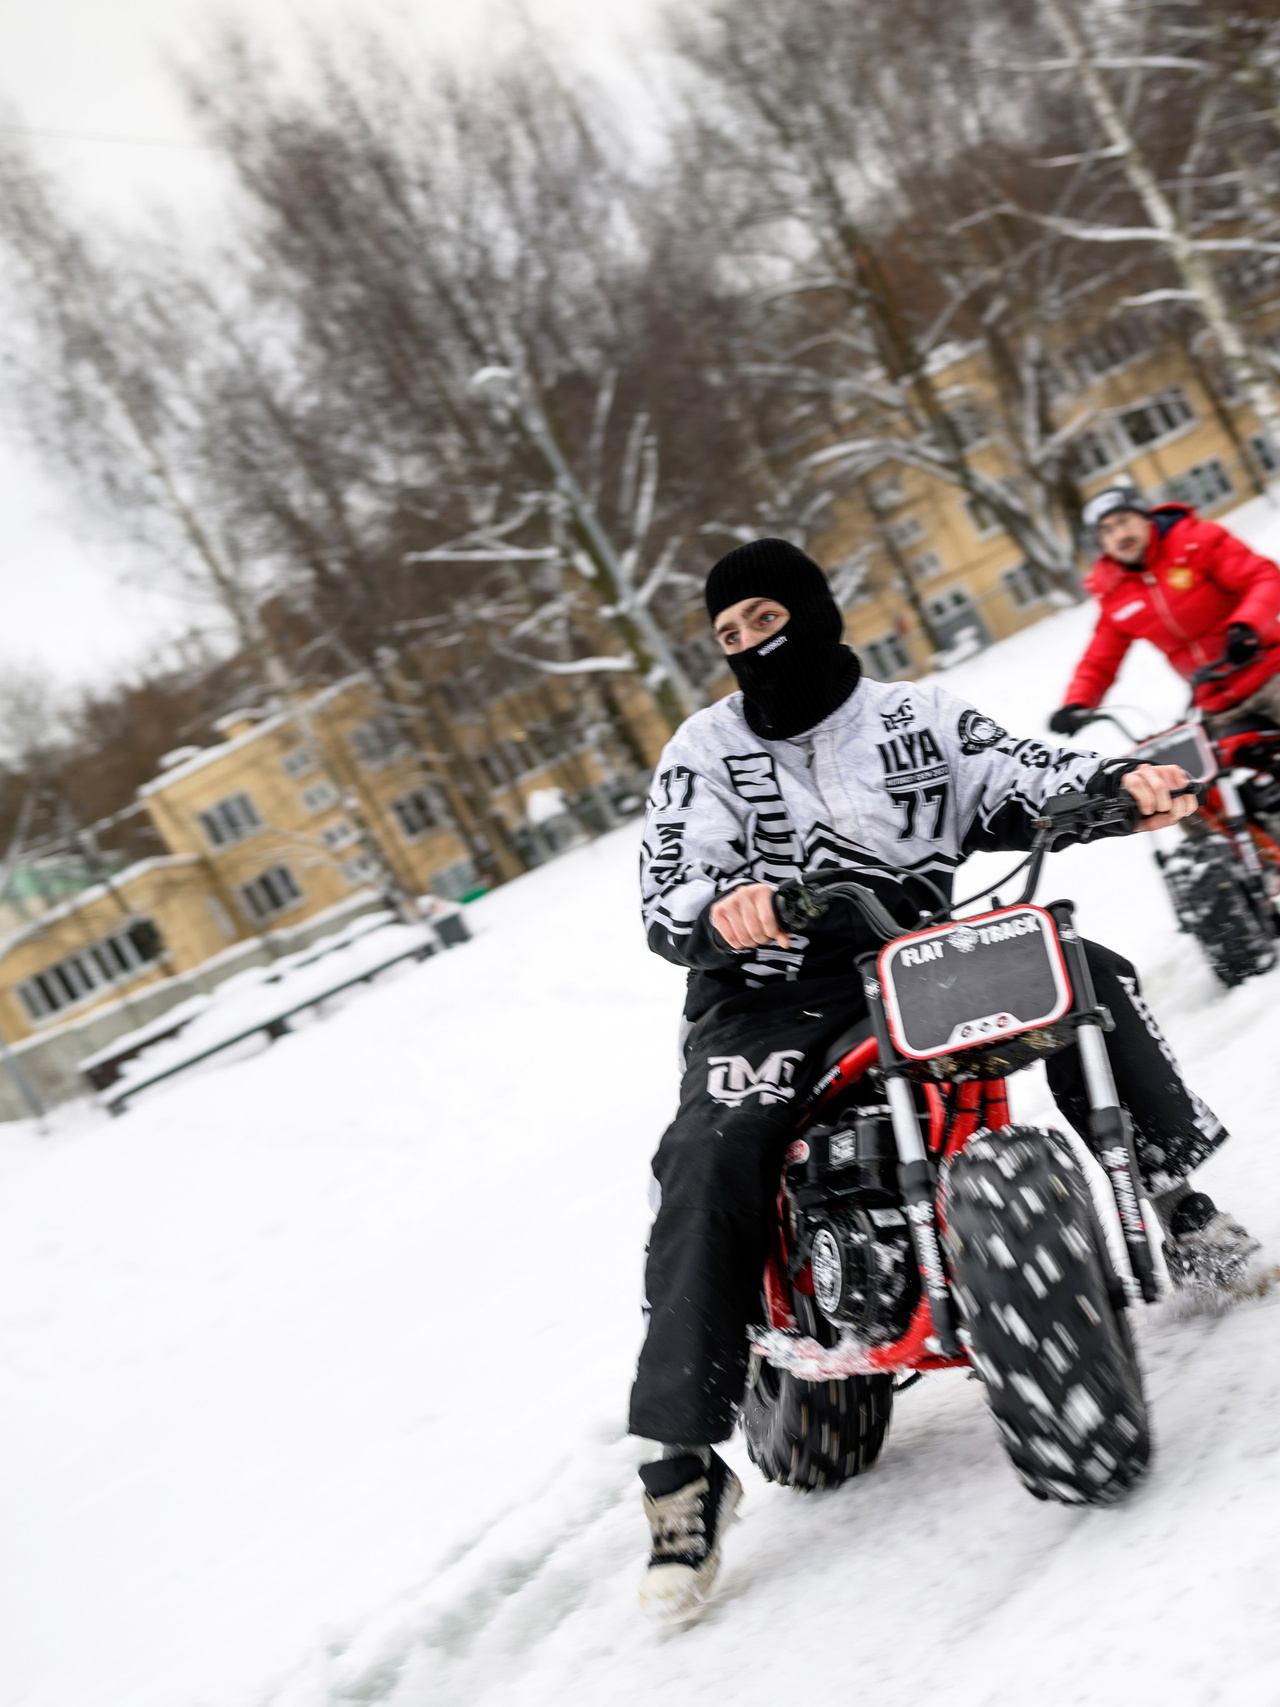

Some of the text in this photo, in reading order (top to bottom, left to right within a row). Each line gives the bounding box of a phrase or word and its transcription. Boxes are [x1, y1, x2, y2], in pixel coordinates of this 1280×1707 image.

[877, 727, 946, 773] ILYA
[660, 764, 698, 812] 77
[886, 781, 949, 842] 77
[900, 940, 945, 968] FLAT
[977, 914, 1042, 946] TRACK
